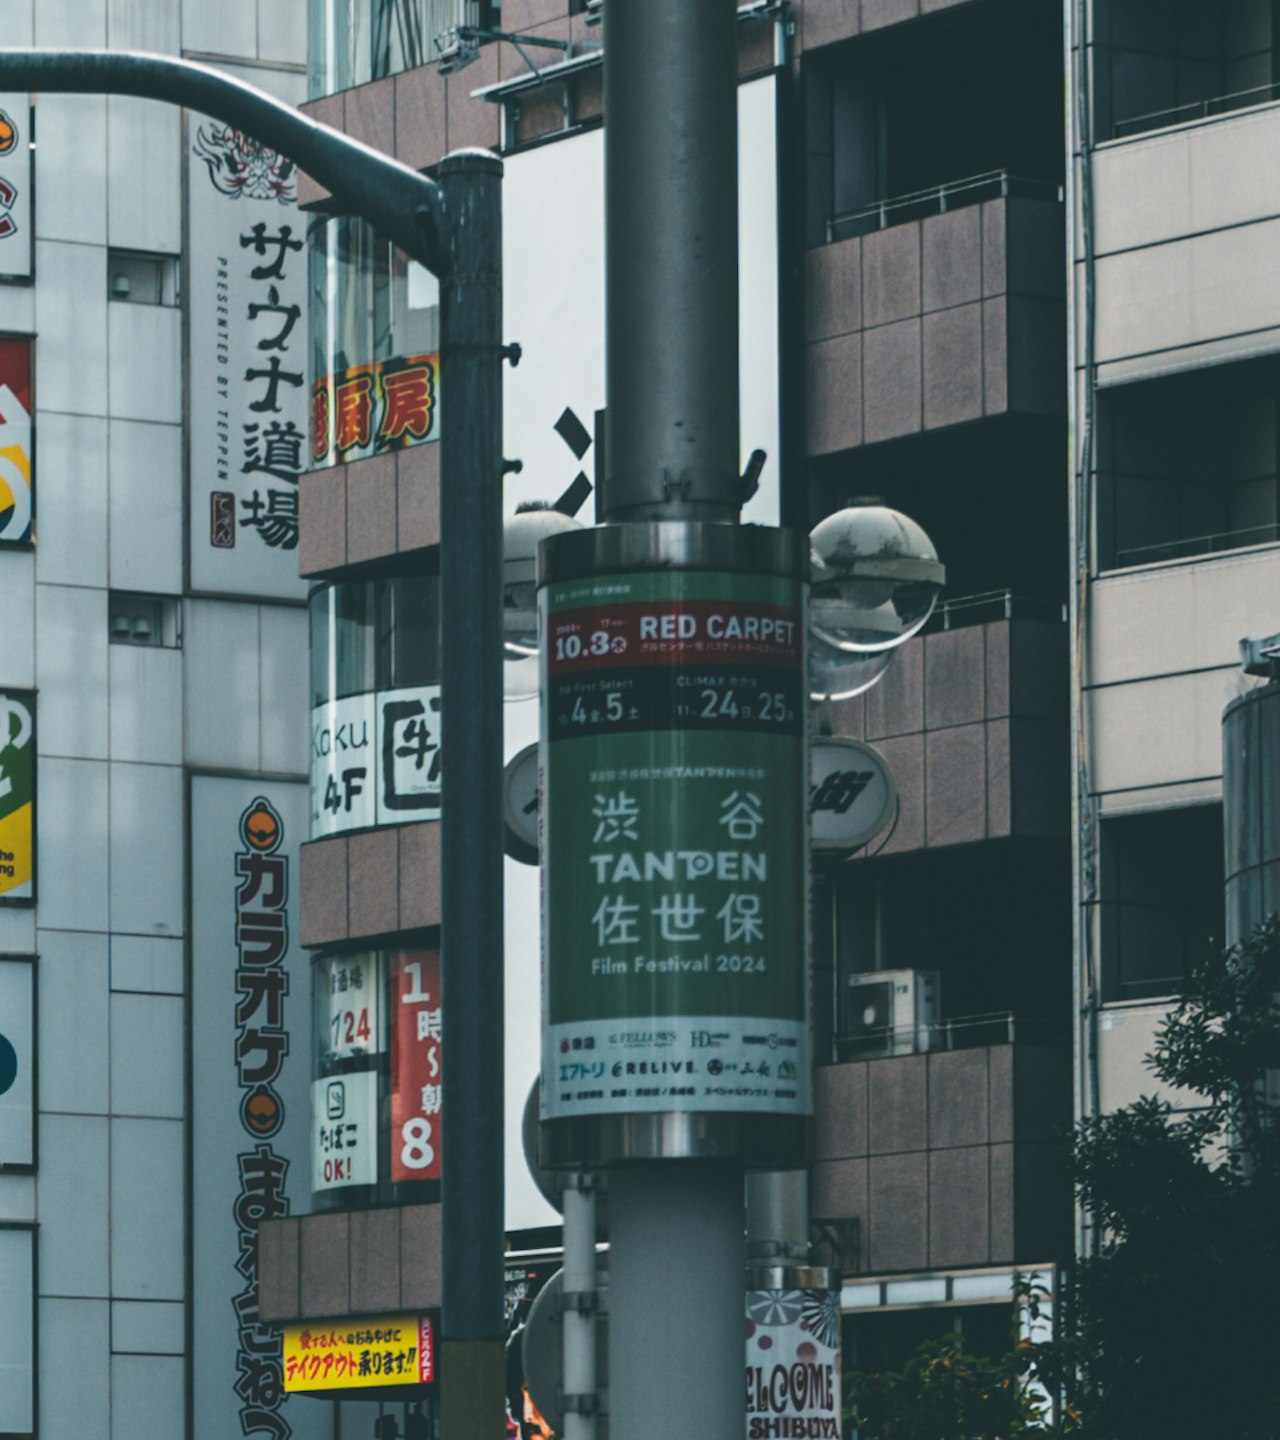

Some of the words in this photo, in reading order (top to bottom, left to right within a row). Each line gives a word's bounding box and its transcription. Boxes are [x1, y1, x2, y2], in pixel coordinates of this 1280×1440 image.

[216, 256, 229, 366] PRESENTED
[216, 374, 229, 400] BY
[238, 222, 306, 550] サウナ道場
[216, 409, 229, 482] TEPPEN
[640, 615, 696, 640] RED
[706, 615, 795, 644] CARPET
[677, 676, 724, 687] CLIMAX
[324, 766, 368, 816] 4F
[590, 850, 767, 884] TANPEN
[591, 893, 764, 947] 佐世保
[235, 850, 288, 1087] カラオケ
[591, 956, 627, 975] Film
[634, 955, 709, 973] Festival
[716, 955, 766, 973] 2024
[320, 1123, 358, 1153] たばこ
[323, 1156, 353, 1184] OK!
[299, 1328, 402, 1350] 愛する人へのおみやげに
[748, 1416, 840, 1440] SHIBUYA
